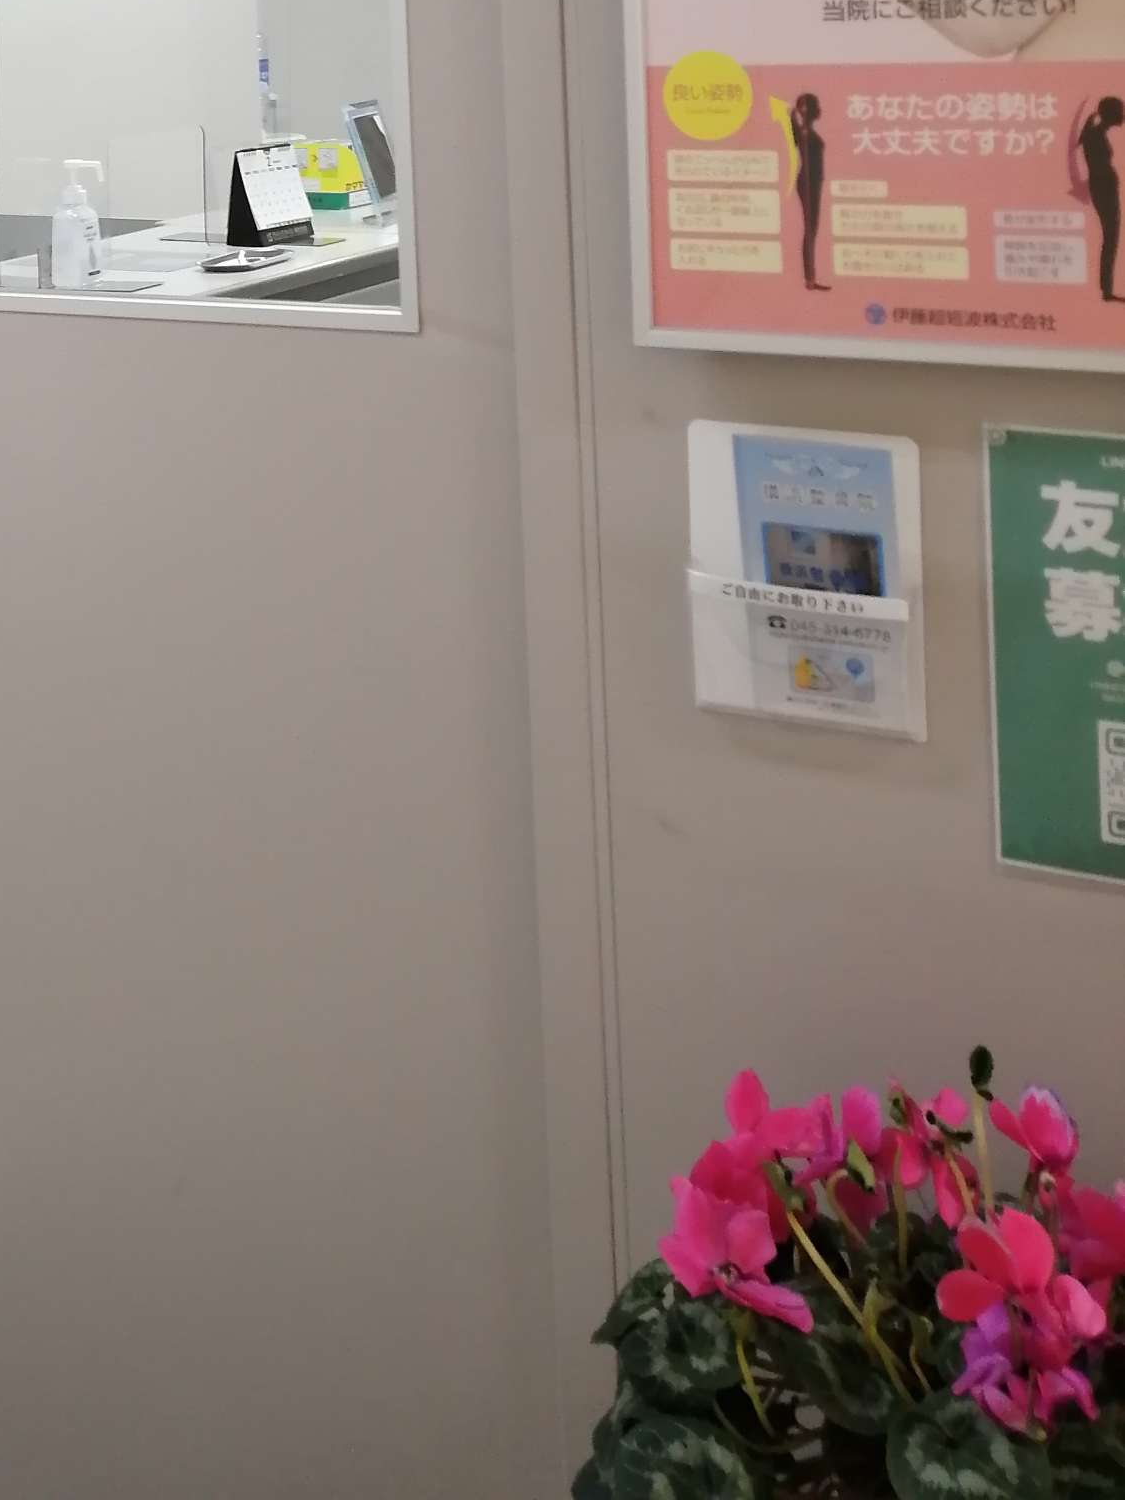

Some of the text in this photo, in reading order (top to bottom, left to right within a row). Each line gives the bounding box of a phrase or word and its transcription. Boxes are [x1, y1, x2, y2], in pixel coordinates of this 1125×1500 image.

[845, 92, 1059, 122] あなたの姿勢は
[1040, 479, 1125, 558] 友
[1043, 566, 1125, 641] 募
